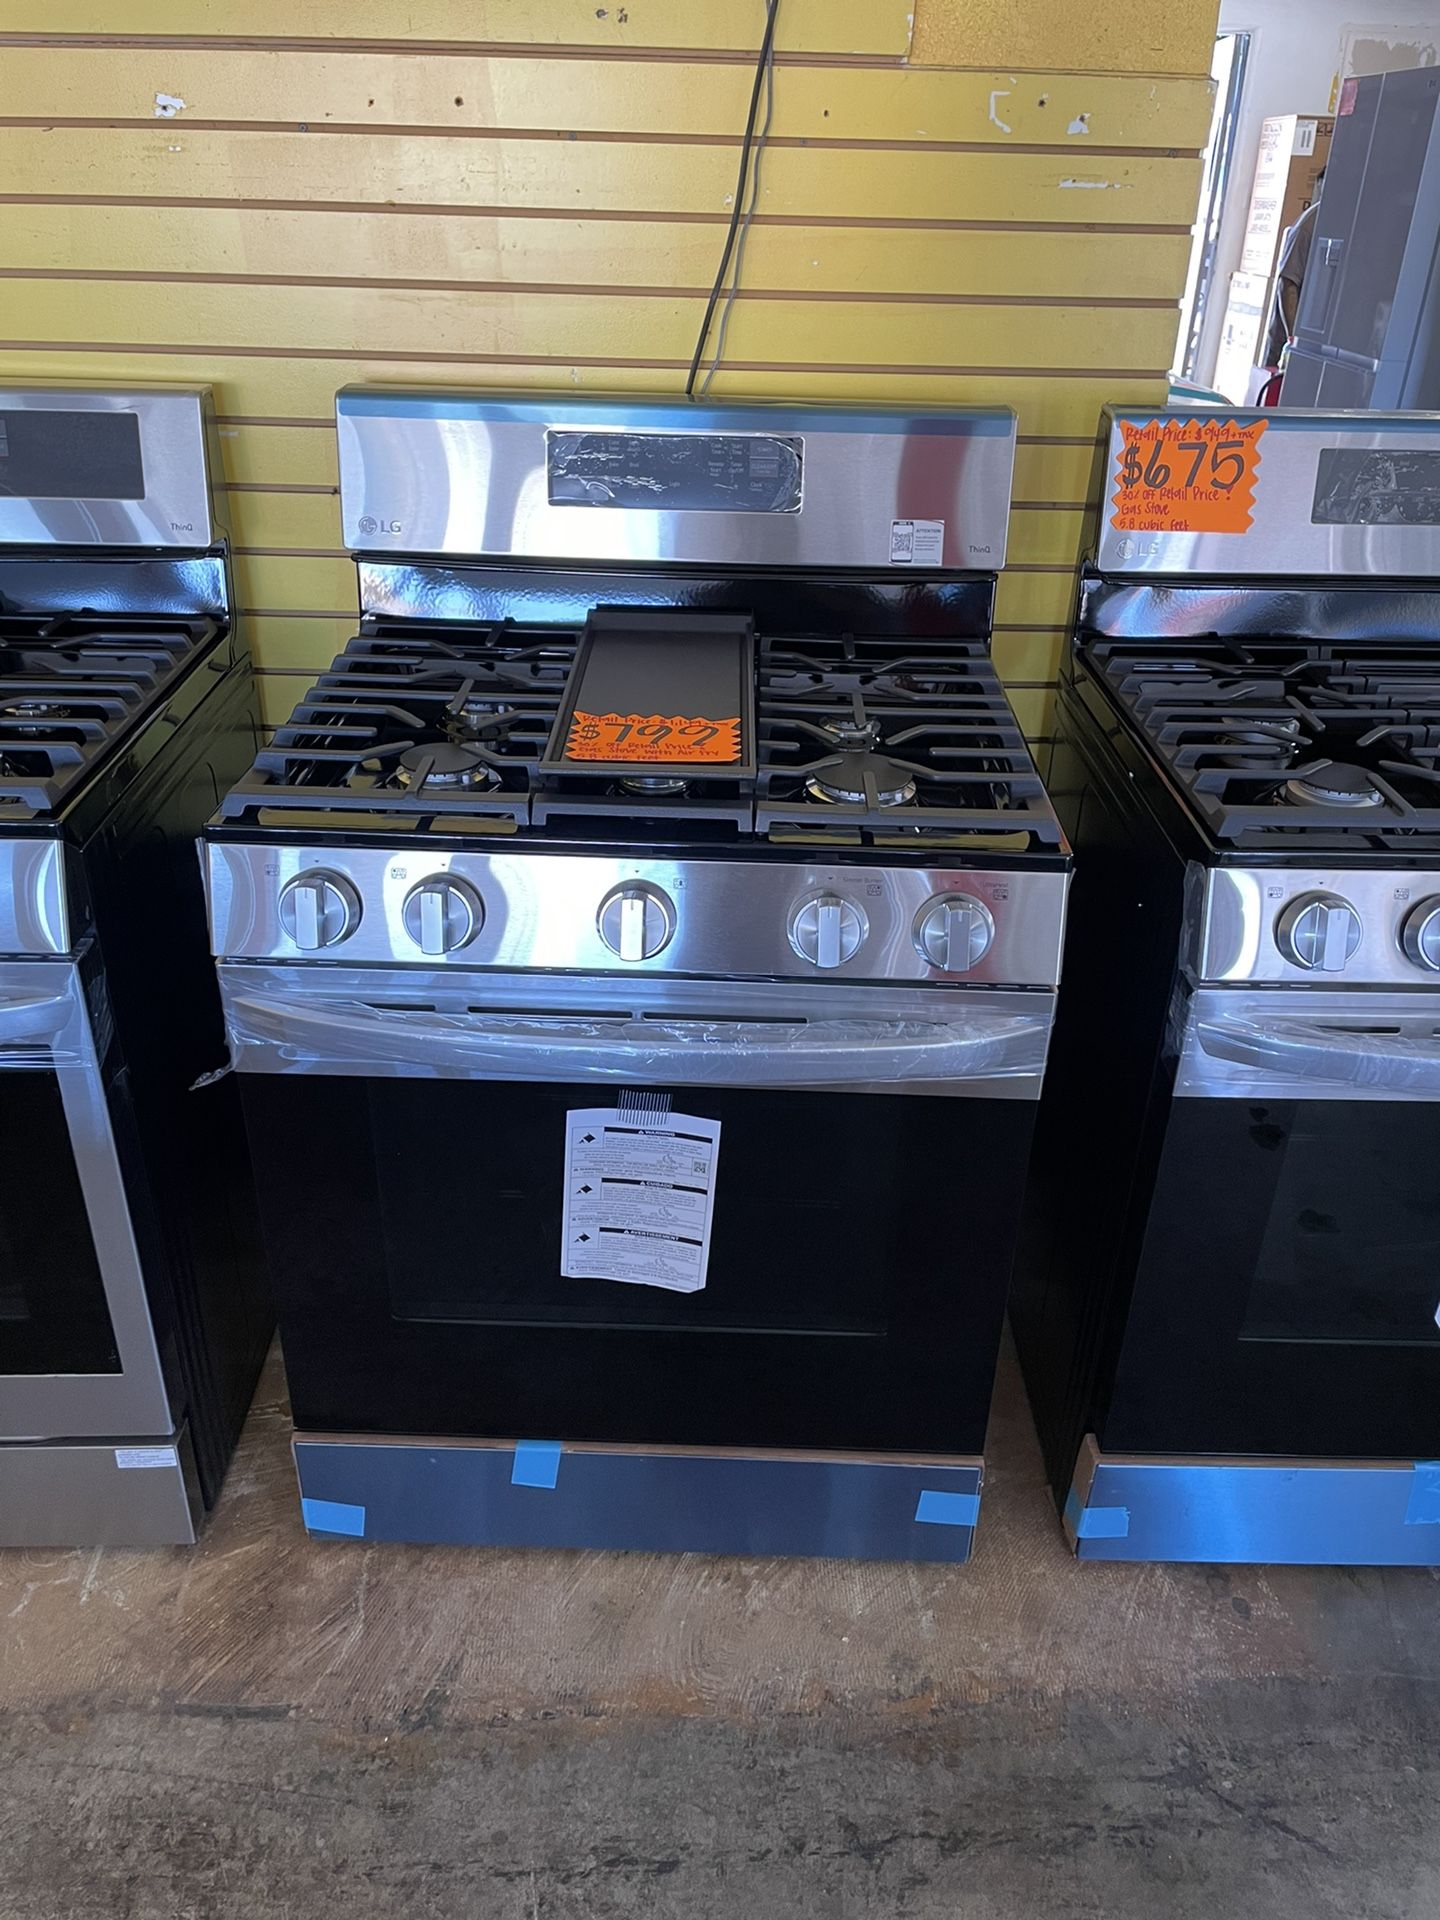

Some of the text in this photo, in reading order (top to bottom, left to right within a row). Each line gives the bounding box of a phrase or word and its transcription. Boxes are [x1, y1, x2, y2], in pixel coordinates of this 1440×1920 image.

[1125, 427, 1159, 442] Retail
[1162, 427, 1192, 442] Price:
[1122, 439, 1245, 490] $675
[1159, 486, 1188, 501] Retail
[1144, 501, 1170, 516] Stove
[170, 522, 193, 531] ThinQ
[381, 519, 402, 533] LG
[1119, 518, 1135, 530] 5.8
[1138, 520, 1164, 531] cubic
[968, 545, 991, 554] ThinQ
[578, 722, 720, 747] $799
